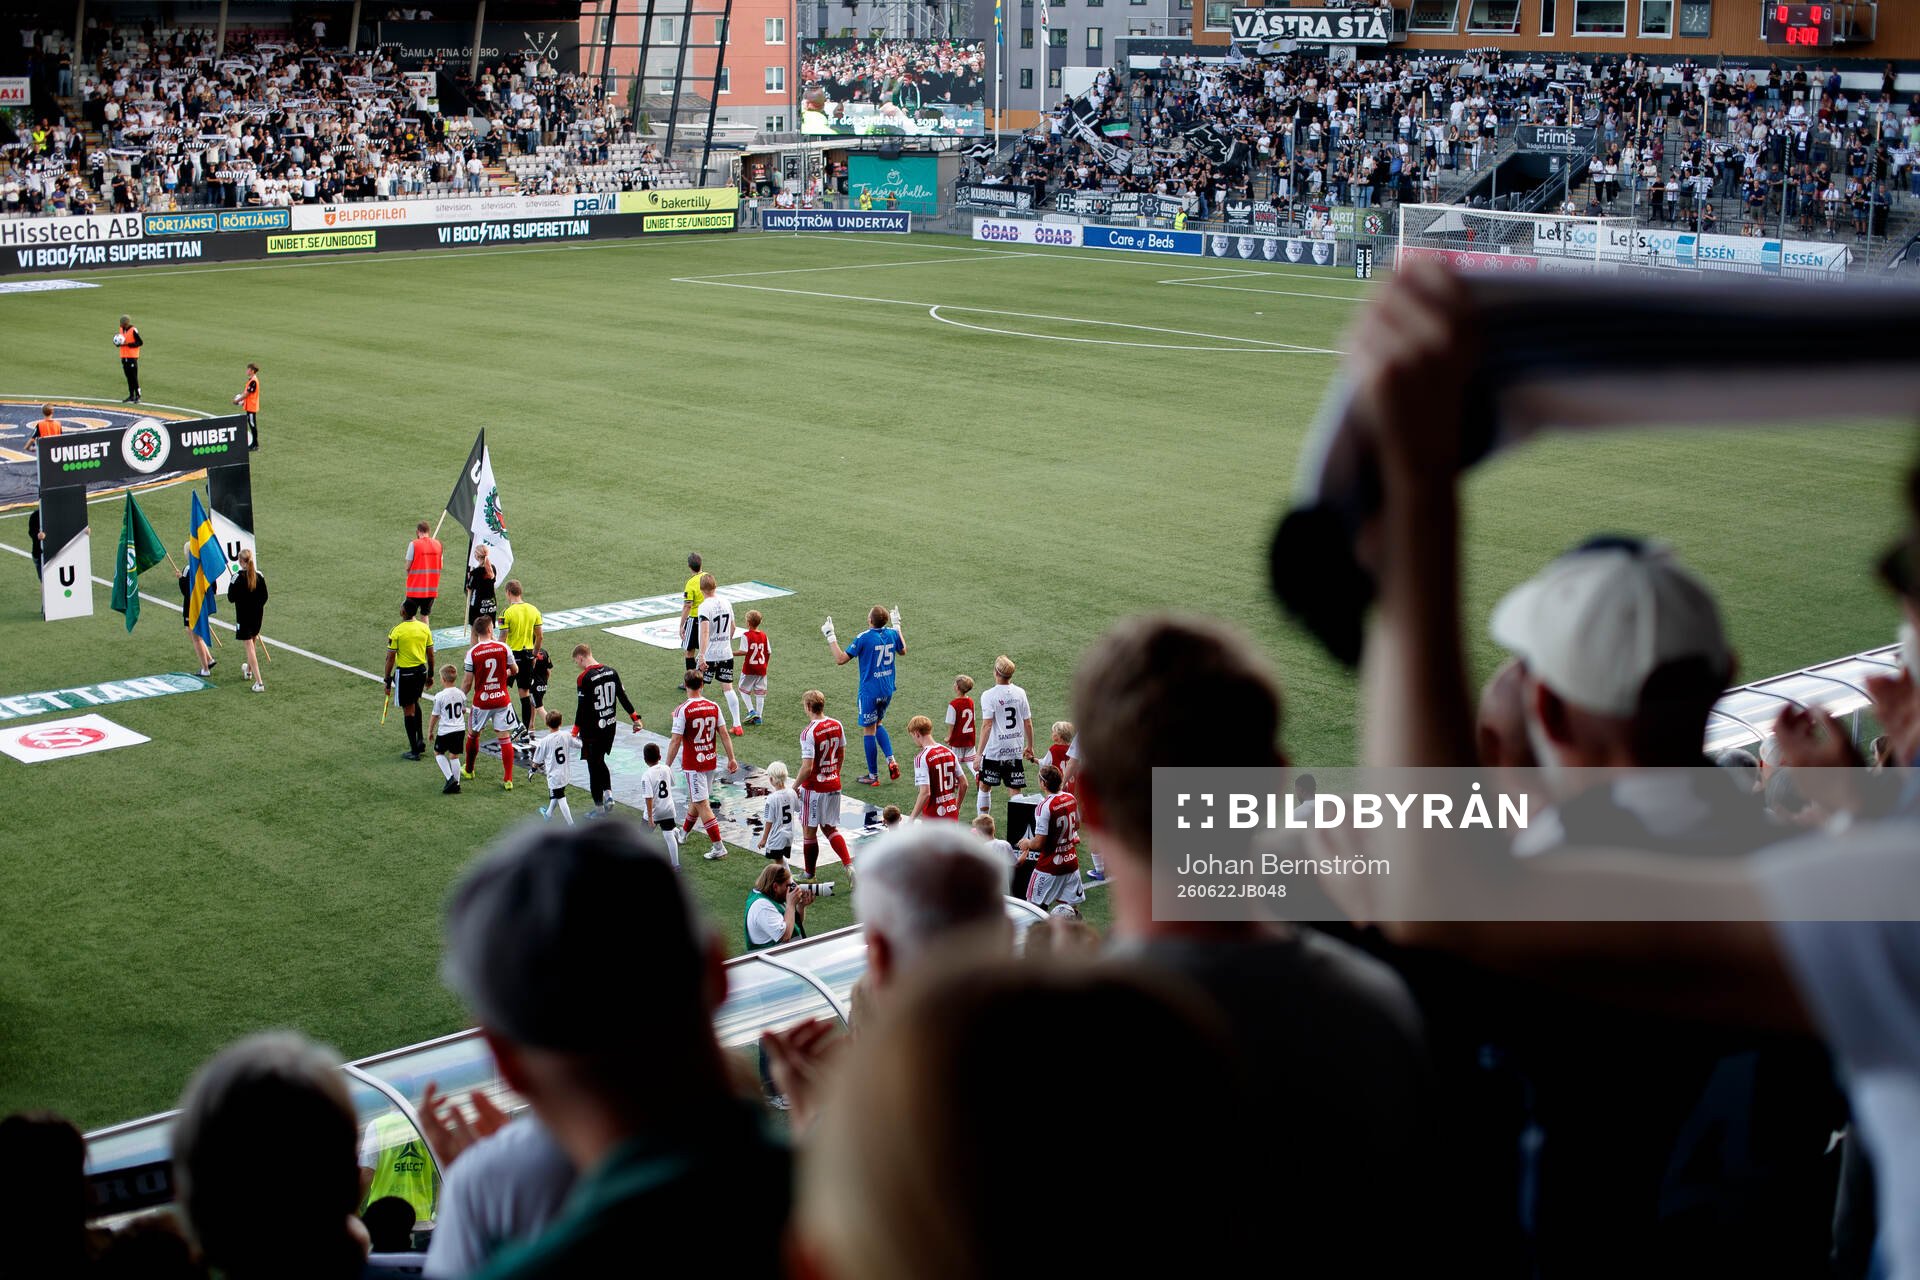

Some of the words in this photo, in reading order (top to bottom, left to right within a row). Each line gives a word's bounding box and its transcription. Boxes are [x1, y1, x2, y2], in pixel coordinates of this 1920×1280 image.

[1234, 9, 1333, 37] VÄSTRA
[1338, 7, 1387, 38] STÅ
[1769, 8, 1777, 20] H
[1777, 5, 1788, 24] 0
[1810, 5, 1822, 24] 0
[1823, 8, 1831, 20] G
[400, 47, 433, 57] GAMLA
[917, 117, 939, 126] som
[958, 118, 974, 126] ser
[1536, 128, 1576, 144] Frimis
[661, 195, 711, 210] bakertilly
[971, 187, 1015, 204] KUBANERNA
[149, 215, 214, 232] RÖRTJÄNST
[222, 213, 286, 228] RÖRTJÄNST
[645, 215, 732, 230] UNIBET.SE/UNIBOOST
[767, 214, 833, 228] LINDSTRÖM
[837, 217, 904, 229] UNDERTAK
[1, 217, 100, 245] Hisstech
[108, 217, 140, 239] AB
[438, 227, 450, 243] VI
[513, 219, 589, 238] SUPERETTAN
[980, 220, 1019, 241] ÖBAB
[1035, 223, 1073, 245] ÖBAB
[1109, 230, 1134, 246] Care
[1137, 237, 1146, 249] of
[1148, 233, 1175, 249] Beds
[270, 233, 373, 250] UNIBET.SE/UNIBOOST
[18, 250, 32, 267] VI
[109, 240, 202, 262] SUPERETTAN
[1697, 244, 1735, 260] ESSÉN
[1784, 252, 1823, 266] ESSÉN
[181, 427, 237, 448] UNIBET
[50, 441, 110, 463] UNIBET
[227, 541, 241, 562] U
[59, 565, 75, 587] U
[713, 614, 729, 633] 17
[749, 643, 765, 665] 23
[875, 644, 894, 667] 75
[485, 658, 498, 683] 2
[489, 690, 506, 699] GIDA
[594, 682, 616, 710] 30
[445, 702, 462, 719] 10
[1004, 707, 1017, 729] 3
[692, 716, 716, 744] 23
[961, 709, 974, 733] 2
[555, 747, 565, 764] 6
[820, 737, 840, 766] 22
[935, 762, 954, 792] 15
[659, 780, 668, 798] 8
[782, 805, 792, 824] 5
[394, 1162, 424, 1173] SELECT
